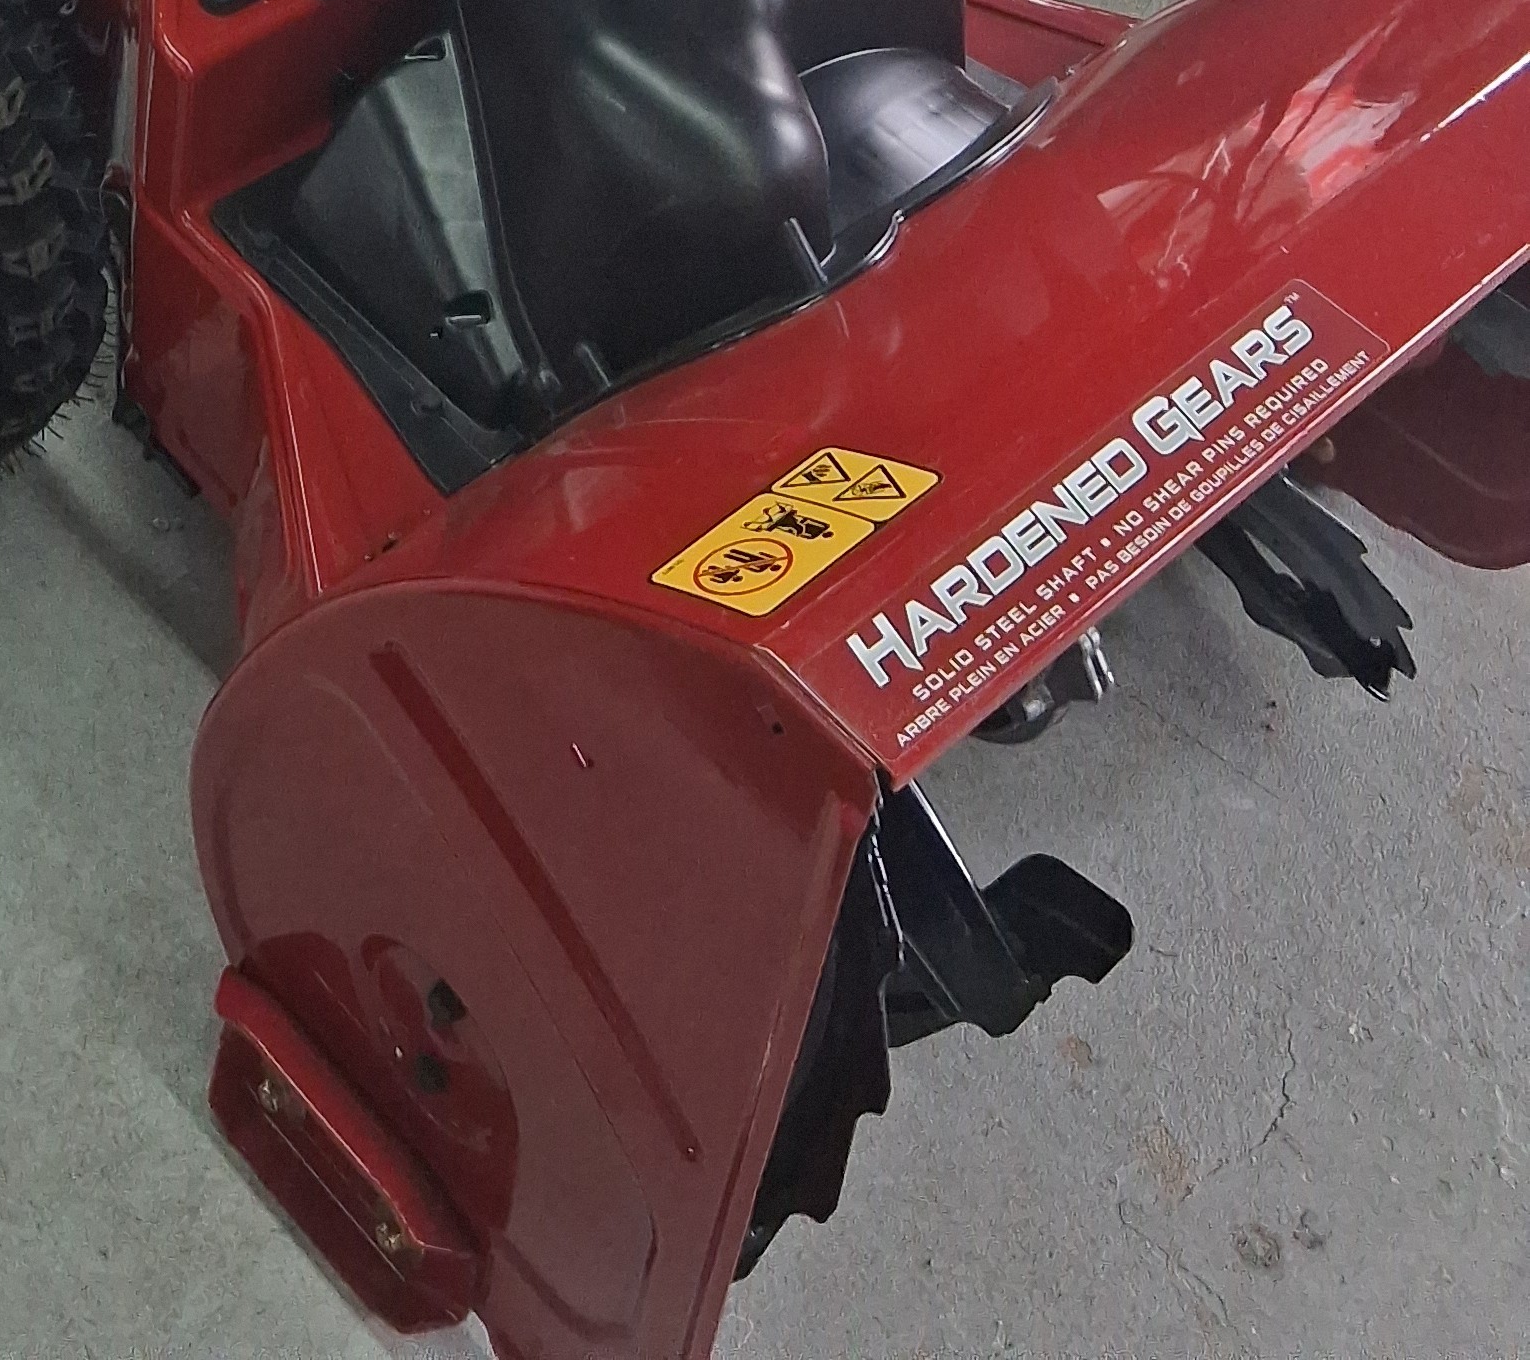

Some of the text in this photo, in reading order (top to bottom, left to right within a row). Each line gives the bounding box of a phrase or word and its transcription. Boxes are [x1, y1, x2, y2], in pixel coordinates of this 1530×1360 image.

[845, 303, 1315, 689] HARDENED GEARS
[895, 349, 1372, 748] ARBRE PLEIN EN ACIER PAS BESOIN DE GOUPILLES DE CISAILLEMENT
[910, 357, 1330, 702] SOLID STEEL SHAFT NO SHEAR PINS REQUIRED
